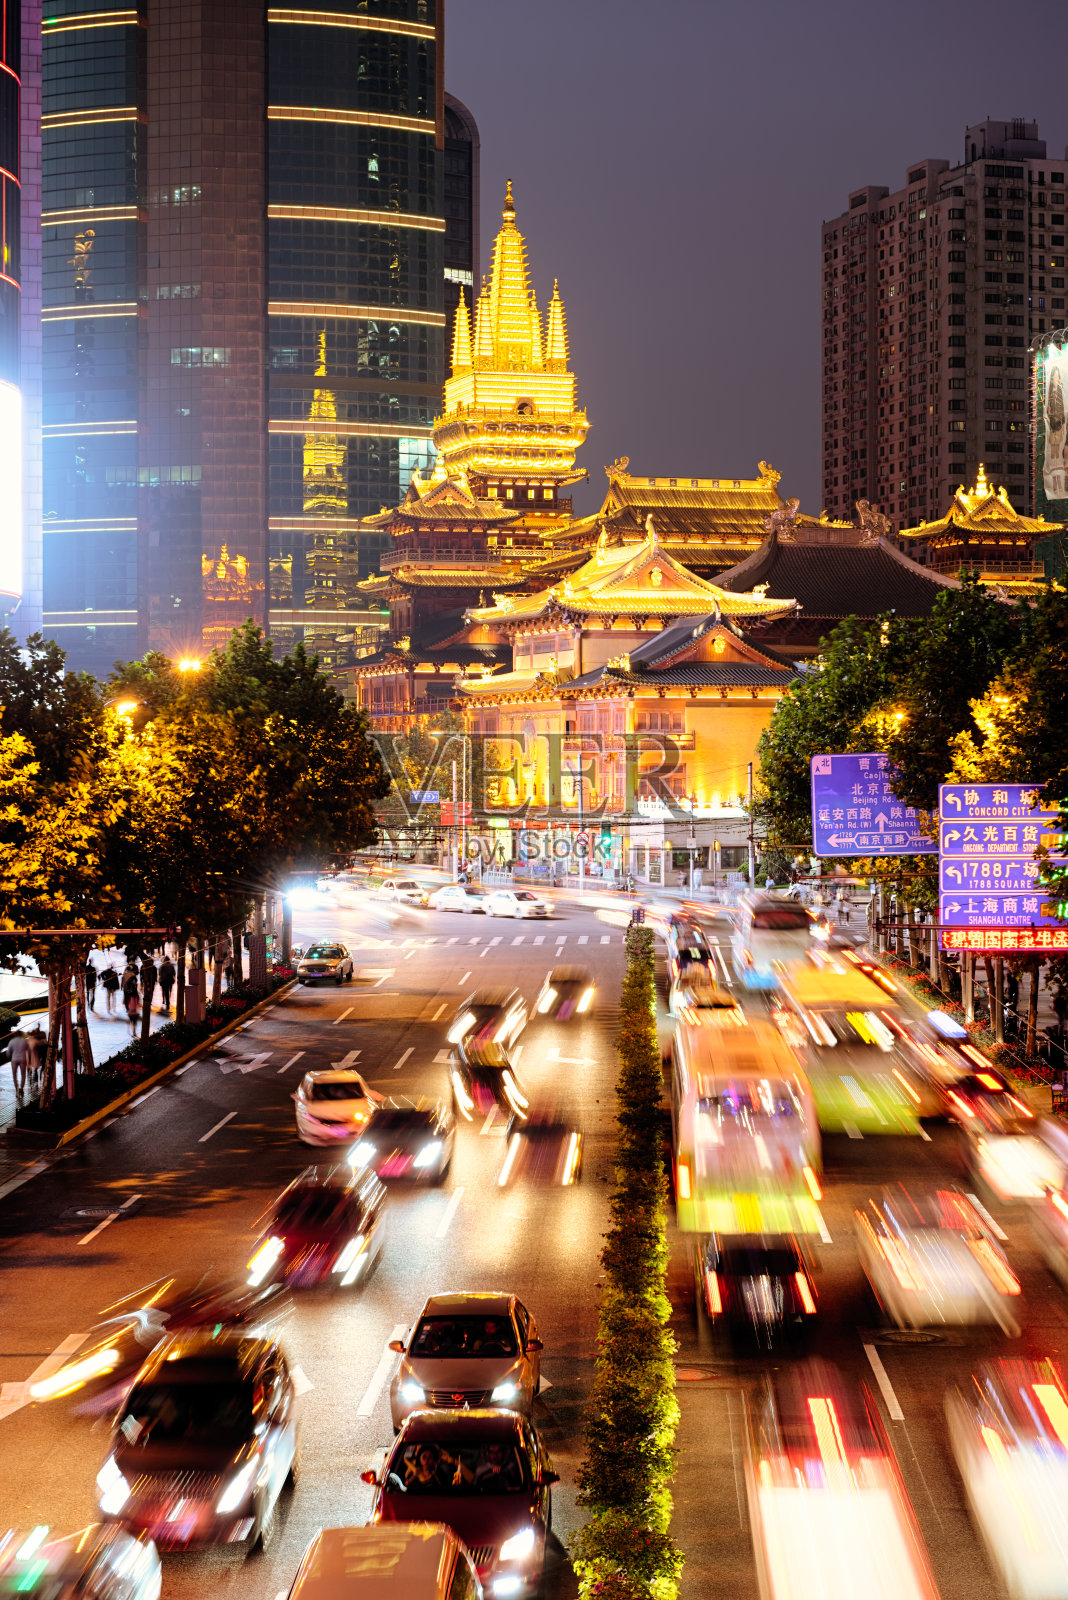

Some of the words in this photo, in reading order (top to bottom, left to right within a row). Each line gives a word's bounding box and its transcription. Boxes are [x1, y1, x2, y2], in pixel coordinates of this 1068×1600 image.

[821, 758, 830, 767] 北
[853, 796, 878, 805] Beijing
[963, 789, 1034, 806] 协和城
[818, 807, 873, 821] 延安西路
[968, 806, 1009, 817] CONCORD
[1011, 806, 1032, 817] CITY
[819, 821, 844, 830] Yan'an
[888, 820, 917, 829] Shaanxi
[962, 825, 1039, 842] 久光百货
[859, 834, 905, 845] 南京西路
[987, 843, 1019, 853] DEPARTMENT
[1022, 843, 1039, 853] STORE
[962, 861, 1040, 878] 1788广场
[969, 879, 992, 889] 1788
[994, 879, 1033, 889] SQUARE
[962, 897, 1039, 914] 上海商城
[968, 915, 1004, 925] SHANGHAI
[1005, 915, 1032, 925] CENTRE
